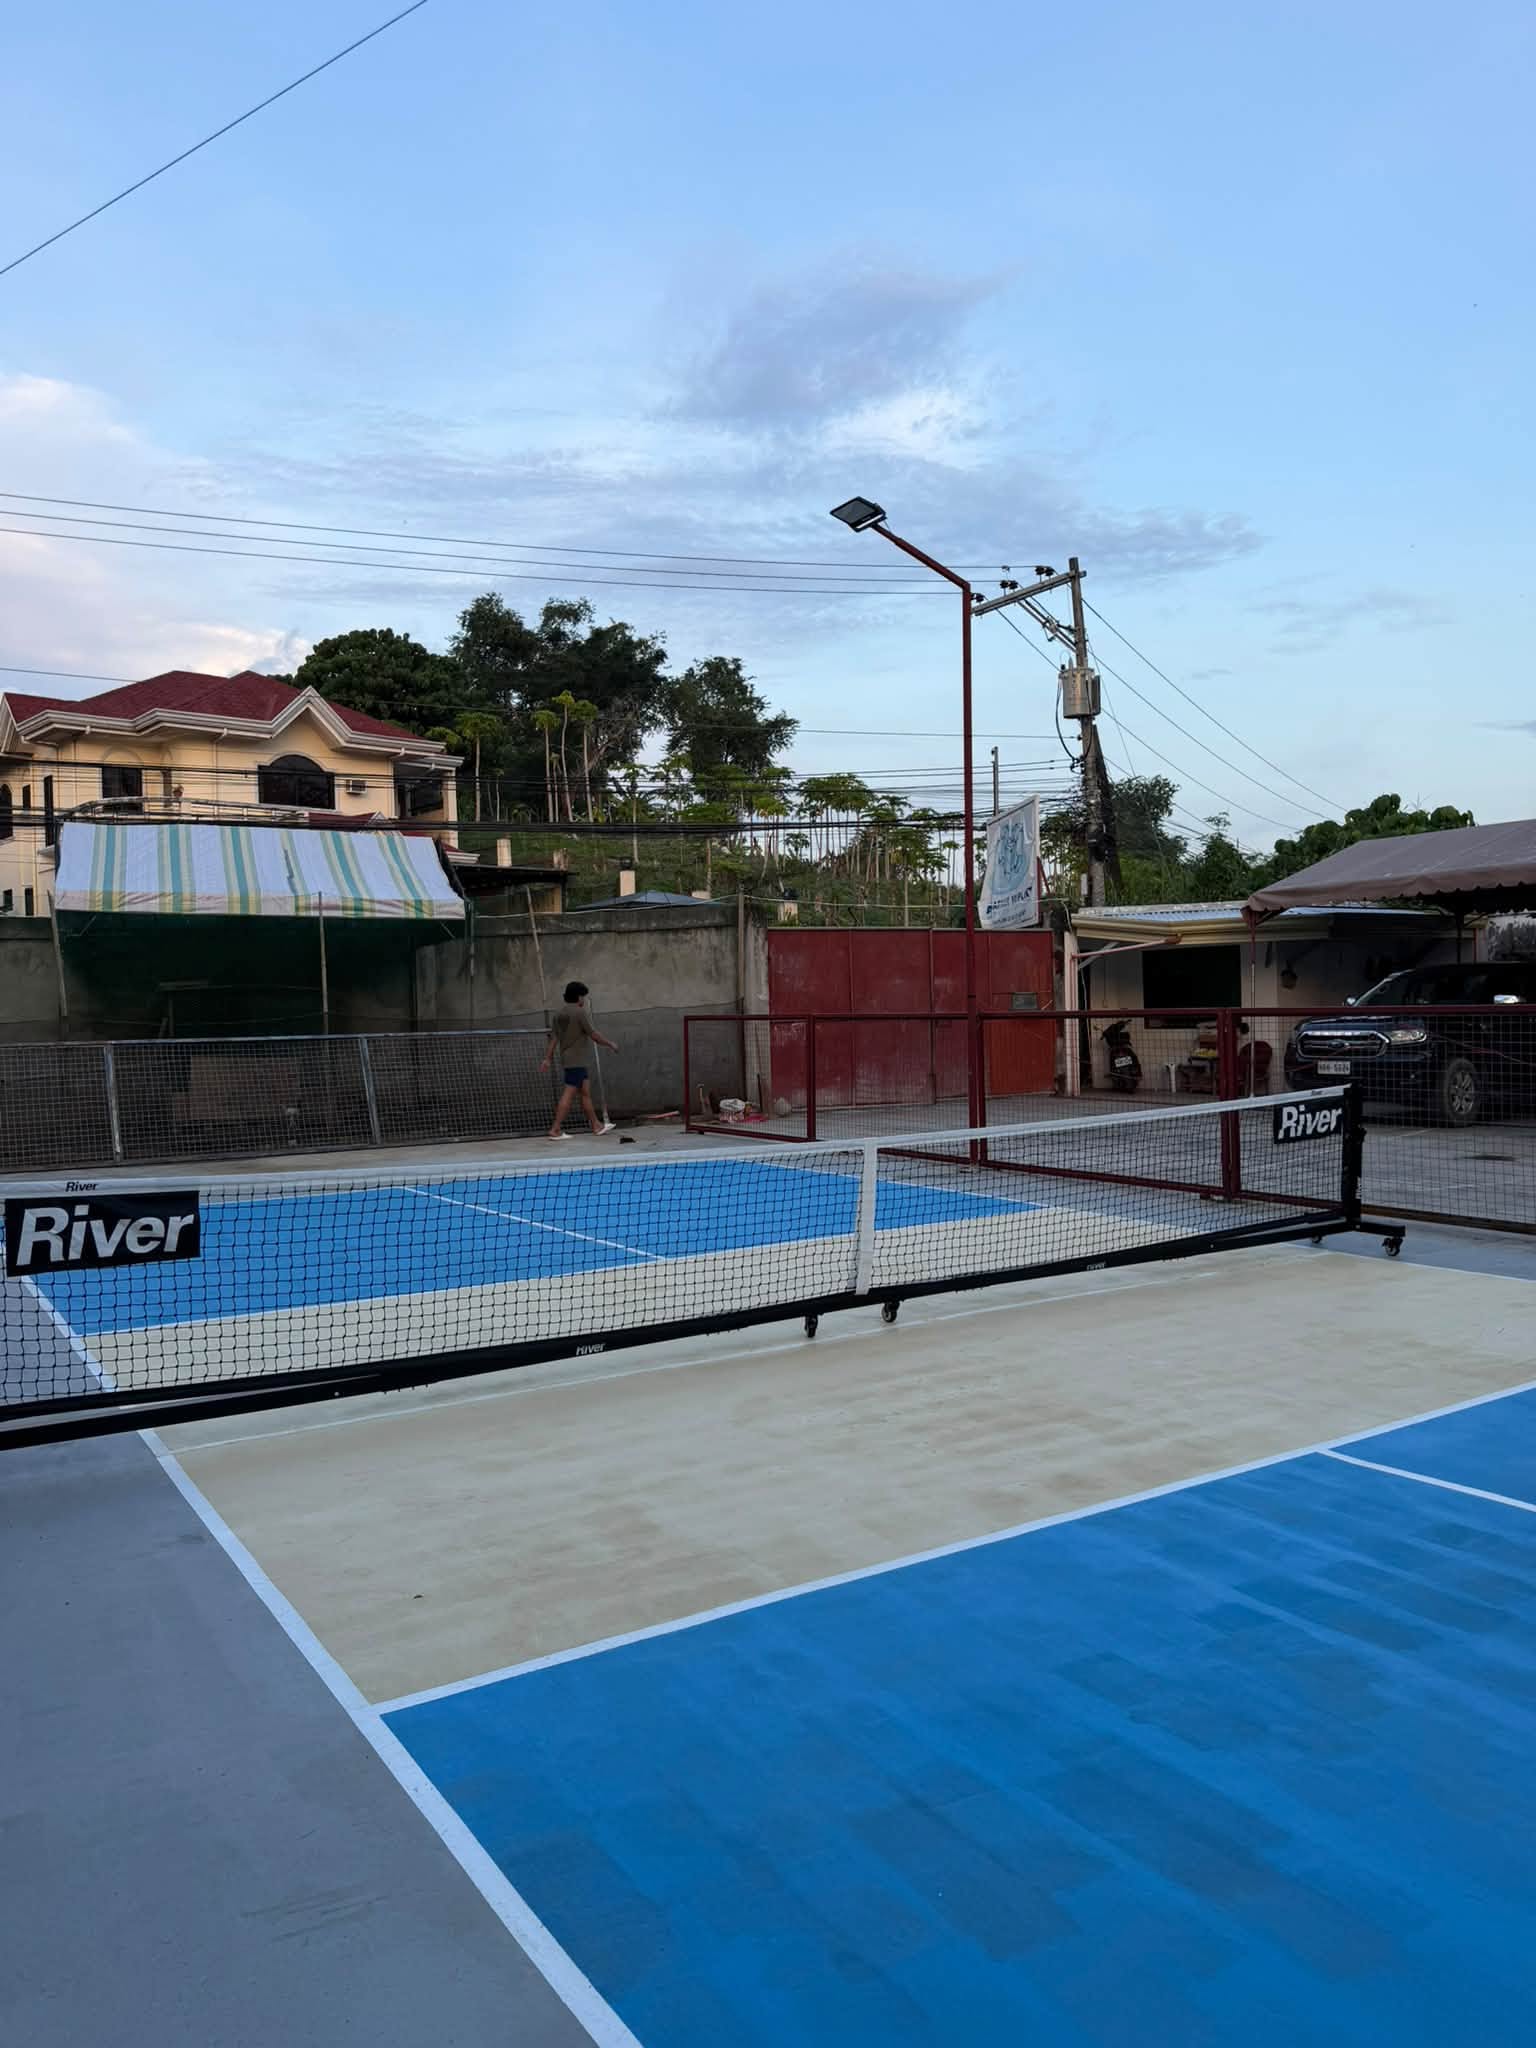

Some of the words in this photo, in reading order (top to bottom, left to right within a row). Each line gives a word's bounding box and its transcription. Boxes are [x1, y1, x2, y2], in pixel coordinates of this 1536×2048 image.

[1278, 1104, 1342, 1139] River
[65, 1181, 99, 1192] River
[16, 1204, 195, 1267] River
